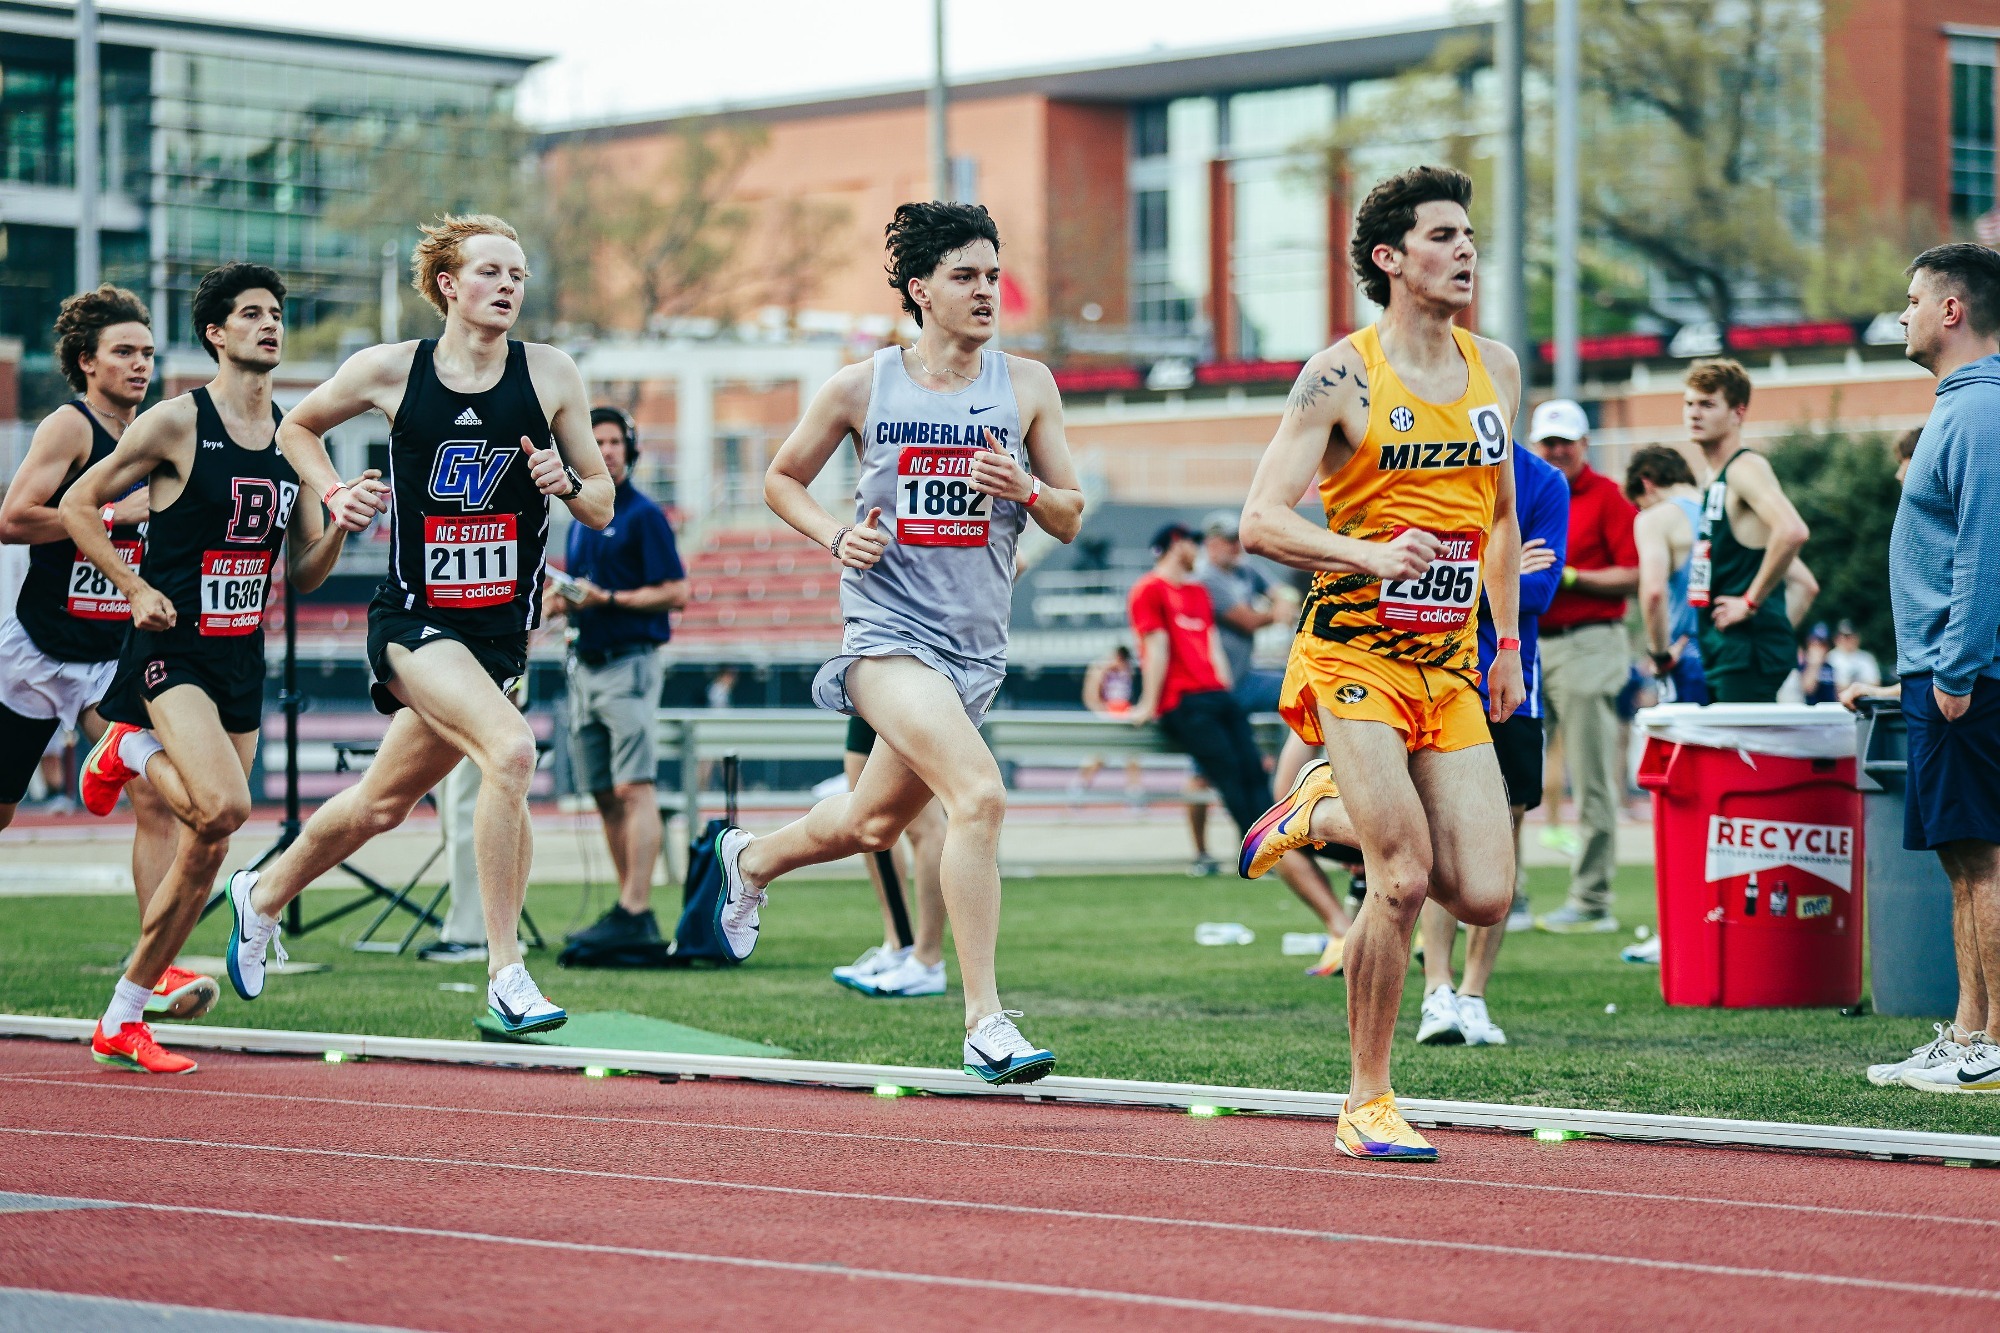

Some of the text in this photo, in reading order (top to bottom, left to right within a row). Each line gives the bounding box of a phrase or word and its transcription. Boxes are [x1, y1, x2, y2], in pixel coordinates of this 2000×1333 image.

[1389, 406, 1414, 432] SEC
[876, 422, 1009, 449] CUMBERLANDS
[1477, 410, 1505, 459] 9
[909, 456, 973, 475] NC STAT
[1379, 441, 1500, 470] MIZZO
[428, 440, 520, 511] GV
[225, 476, 278, 544] B
[280, 486, 296, 526] 3
[904, 480, 988, 517] 1882
[436, 523, 507, 542] NC STATE
[937, 523, 984, 536] adidas
[211, 558, 266, 575] NC STATE
[430, 545, 507, 580] 2111
[206, 578, 262, 610] 1636
[465, 584, 512, 599] adidas
[1385, 565, 1475, 604] 2395
[98, 601, 132, 614] adidas
[231, 614, 260, 628] adidas
[1419, 608, 1467, 624] adidas
[144, 660, 168, 689] B
[1717, 821, 1849, 856] RECYCLE
